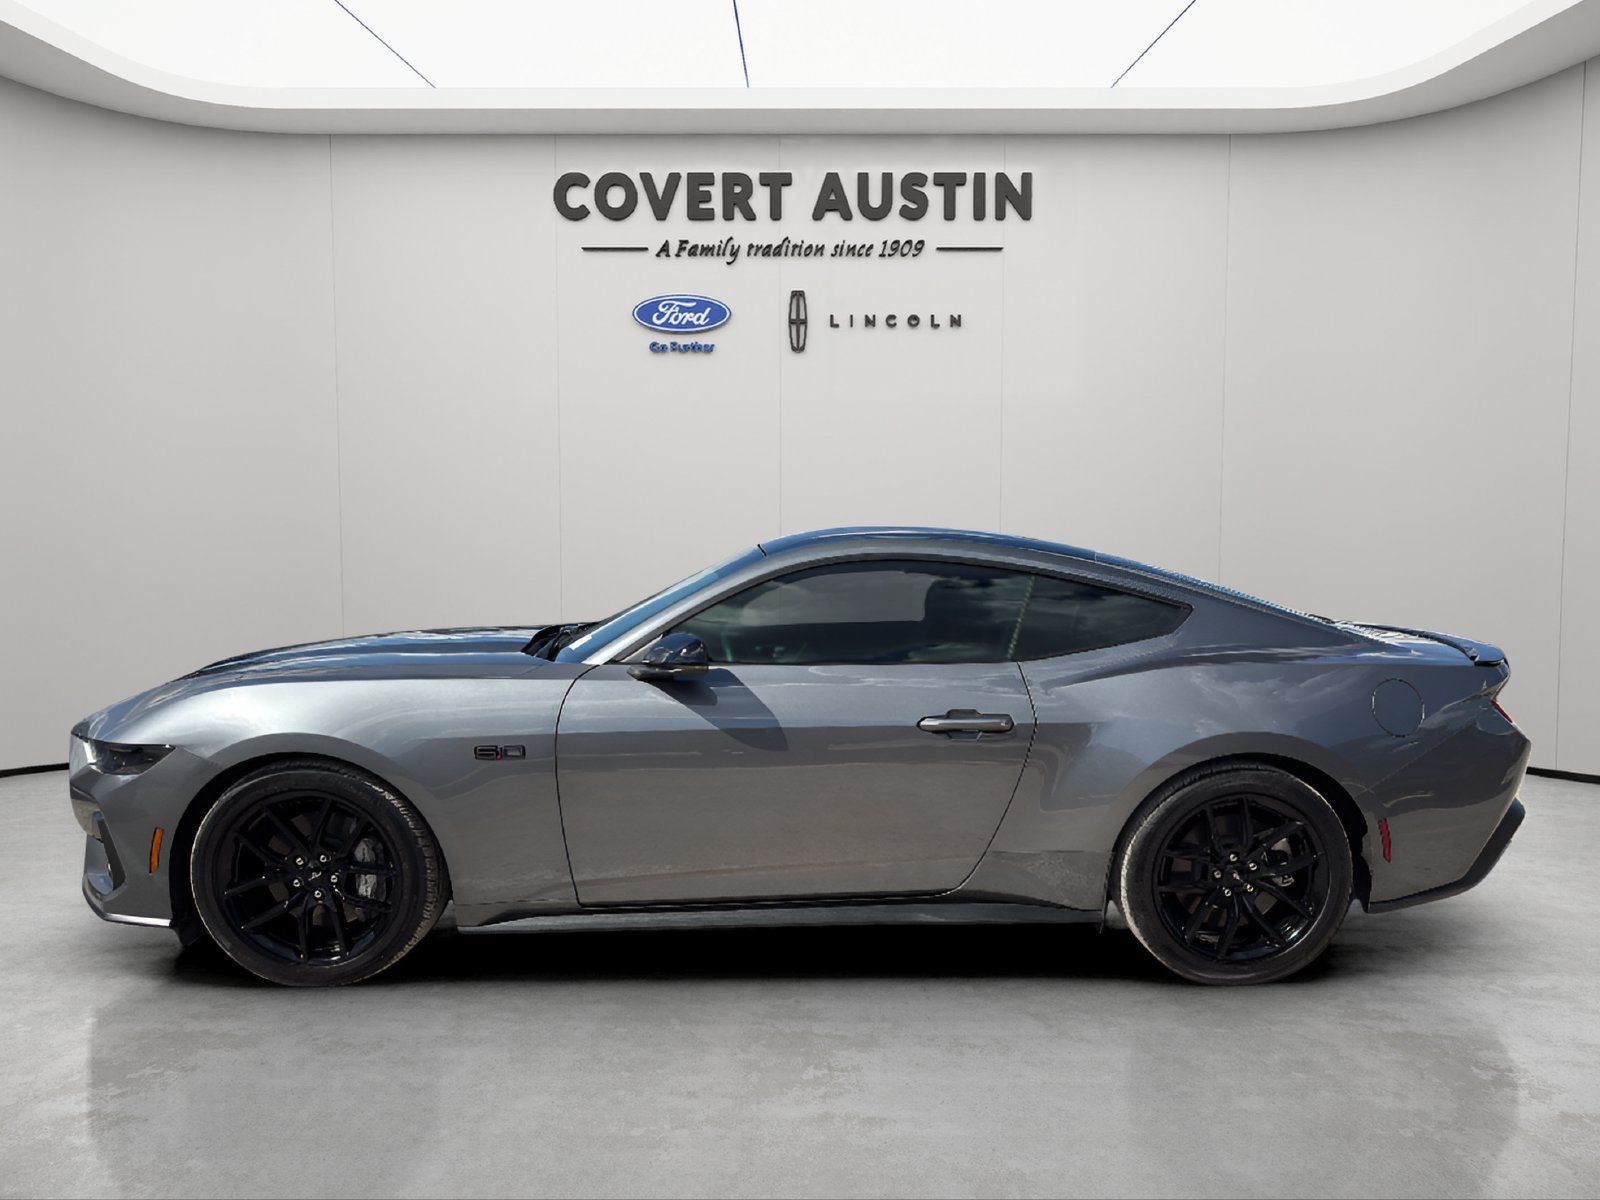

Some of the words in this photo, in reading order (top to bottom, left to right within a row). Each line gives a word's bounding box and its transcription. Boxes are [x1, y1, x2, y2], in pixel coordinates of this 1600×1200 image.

[553, 172, 793, 222] COVERT
[811, 171, 1033, 222] AUSTIN
[655, 239, 671, 258] A
[674, 236, 741, 266] Family
[746, 236, 826, 258] tradition
[830, 239, 875, 258] since
[878, 239, 926, 258] 1909
[651, 300, 712, 325] Ford
[829, 314, 962, 329] LINCOLN
